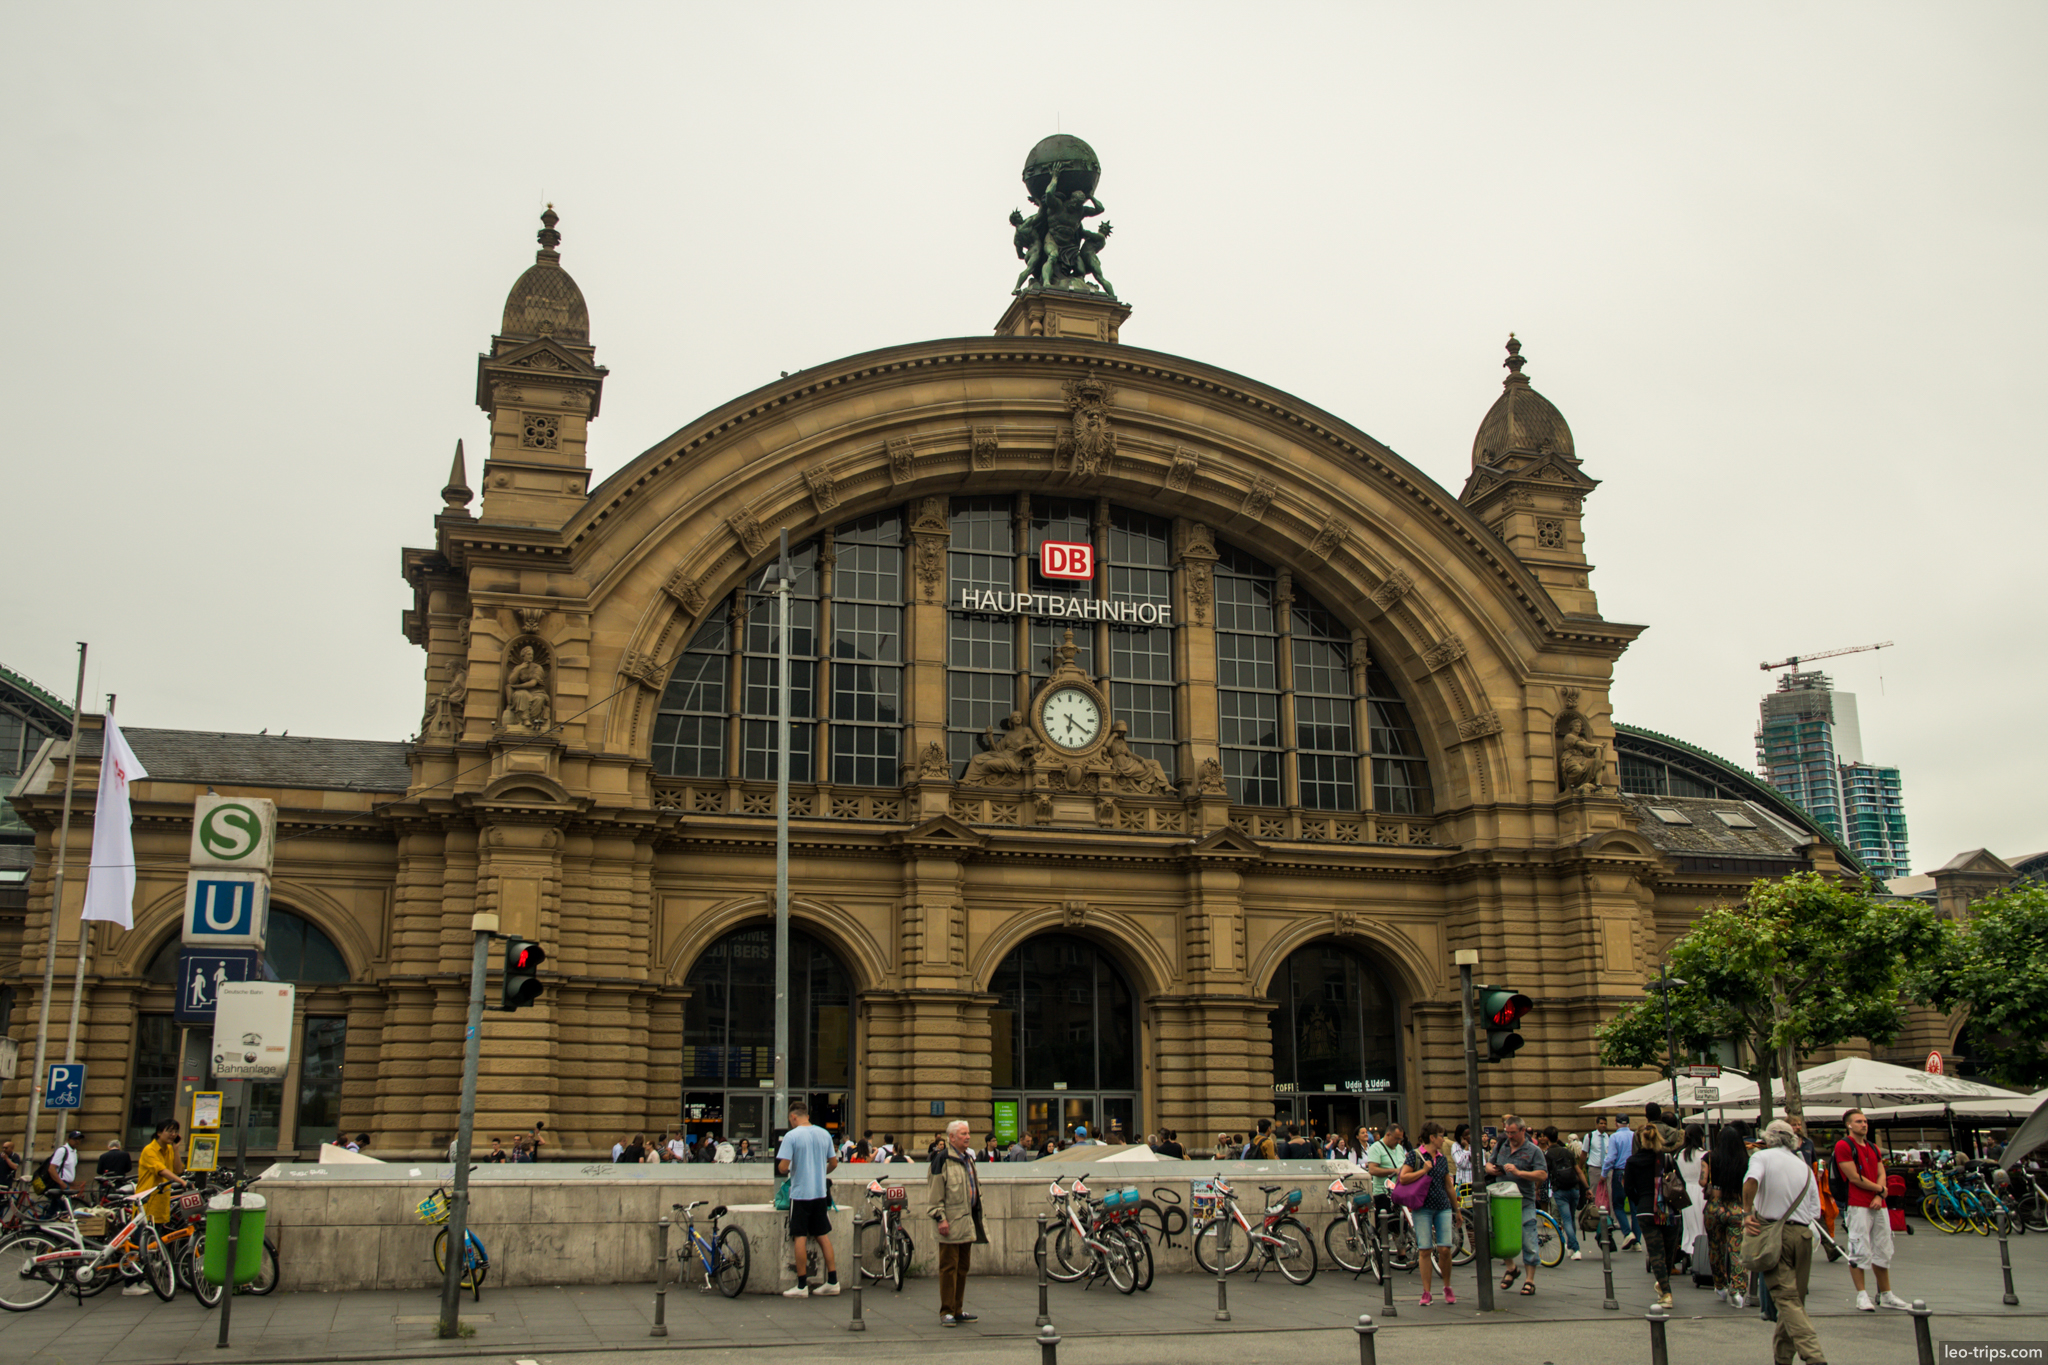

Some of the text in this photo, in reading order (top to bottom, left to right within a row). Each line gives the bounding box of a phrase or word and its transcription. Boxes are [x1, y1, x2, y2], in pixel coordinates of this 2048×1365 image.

[1047, 545, 1088, 574] DB
[961, 588, 1172, 624] HAUPTBAHNHOF
[208, 808, 252, 856] S
[205, 884, 244, 931] U
[216, 1064, 277, 1075] Bahnanlage
[50, 1067, 70, 1091] P
[1275, 1082, 1299, 1092] COFF
[1365, 1079, 1370, 1088] &
[1370, 1079, 1391, 1088] Uddin
[183, 1195, 200, 1208] DB
[889, 1188, 903, 1199] DB
